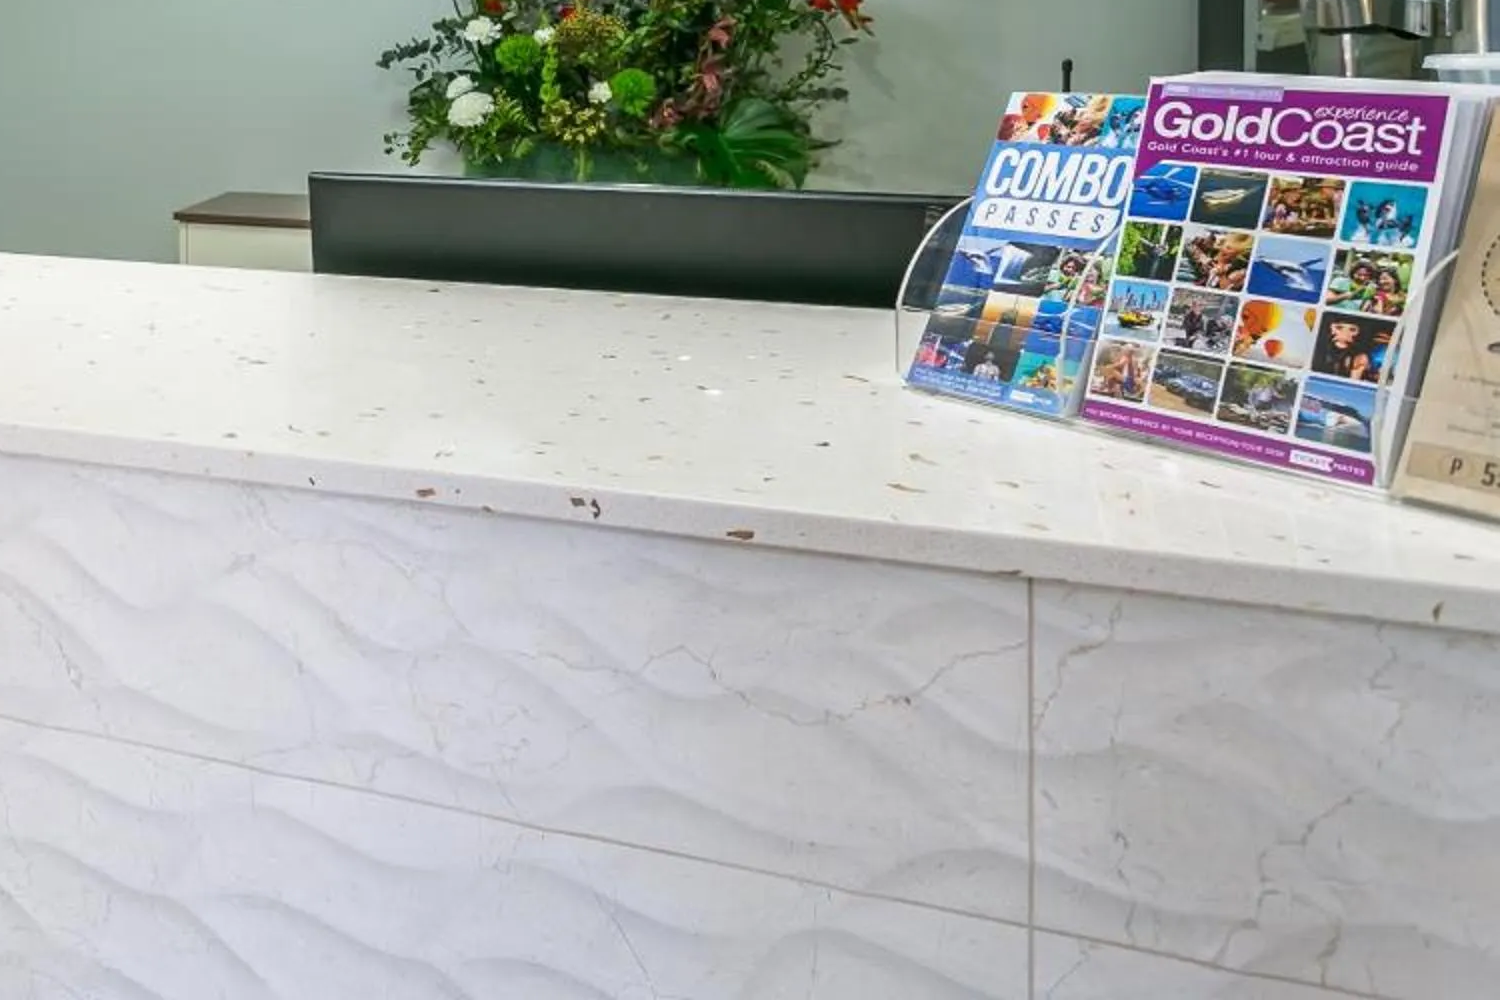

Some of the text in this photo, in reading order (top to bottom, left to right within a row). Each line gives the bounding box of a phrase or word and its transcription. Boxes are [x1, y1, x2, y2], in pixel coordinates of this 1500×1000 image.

[1313, 104, 1410, 122] experience
[1147, 140, 1419, 172] Gold Coast's #1 tour & attraction guide
[985, 148, 1134, 207] COMBO
[985, 203, 1105, 233] PASSES
[1480, 461, 1500, 488] 5
